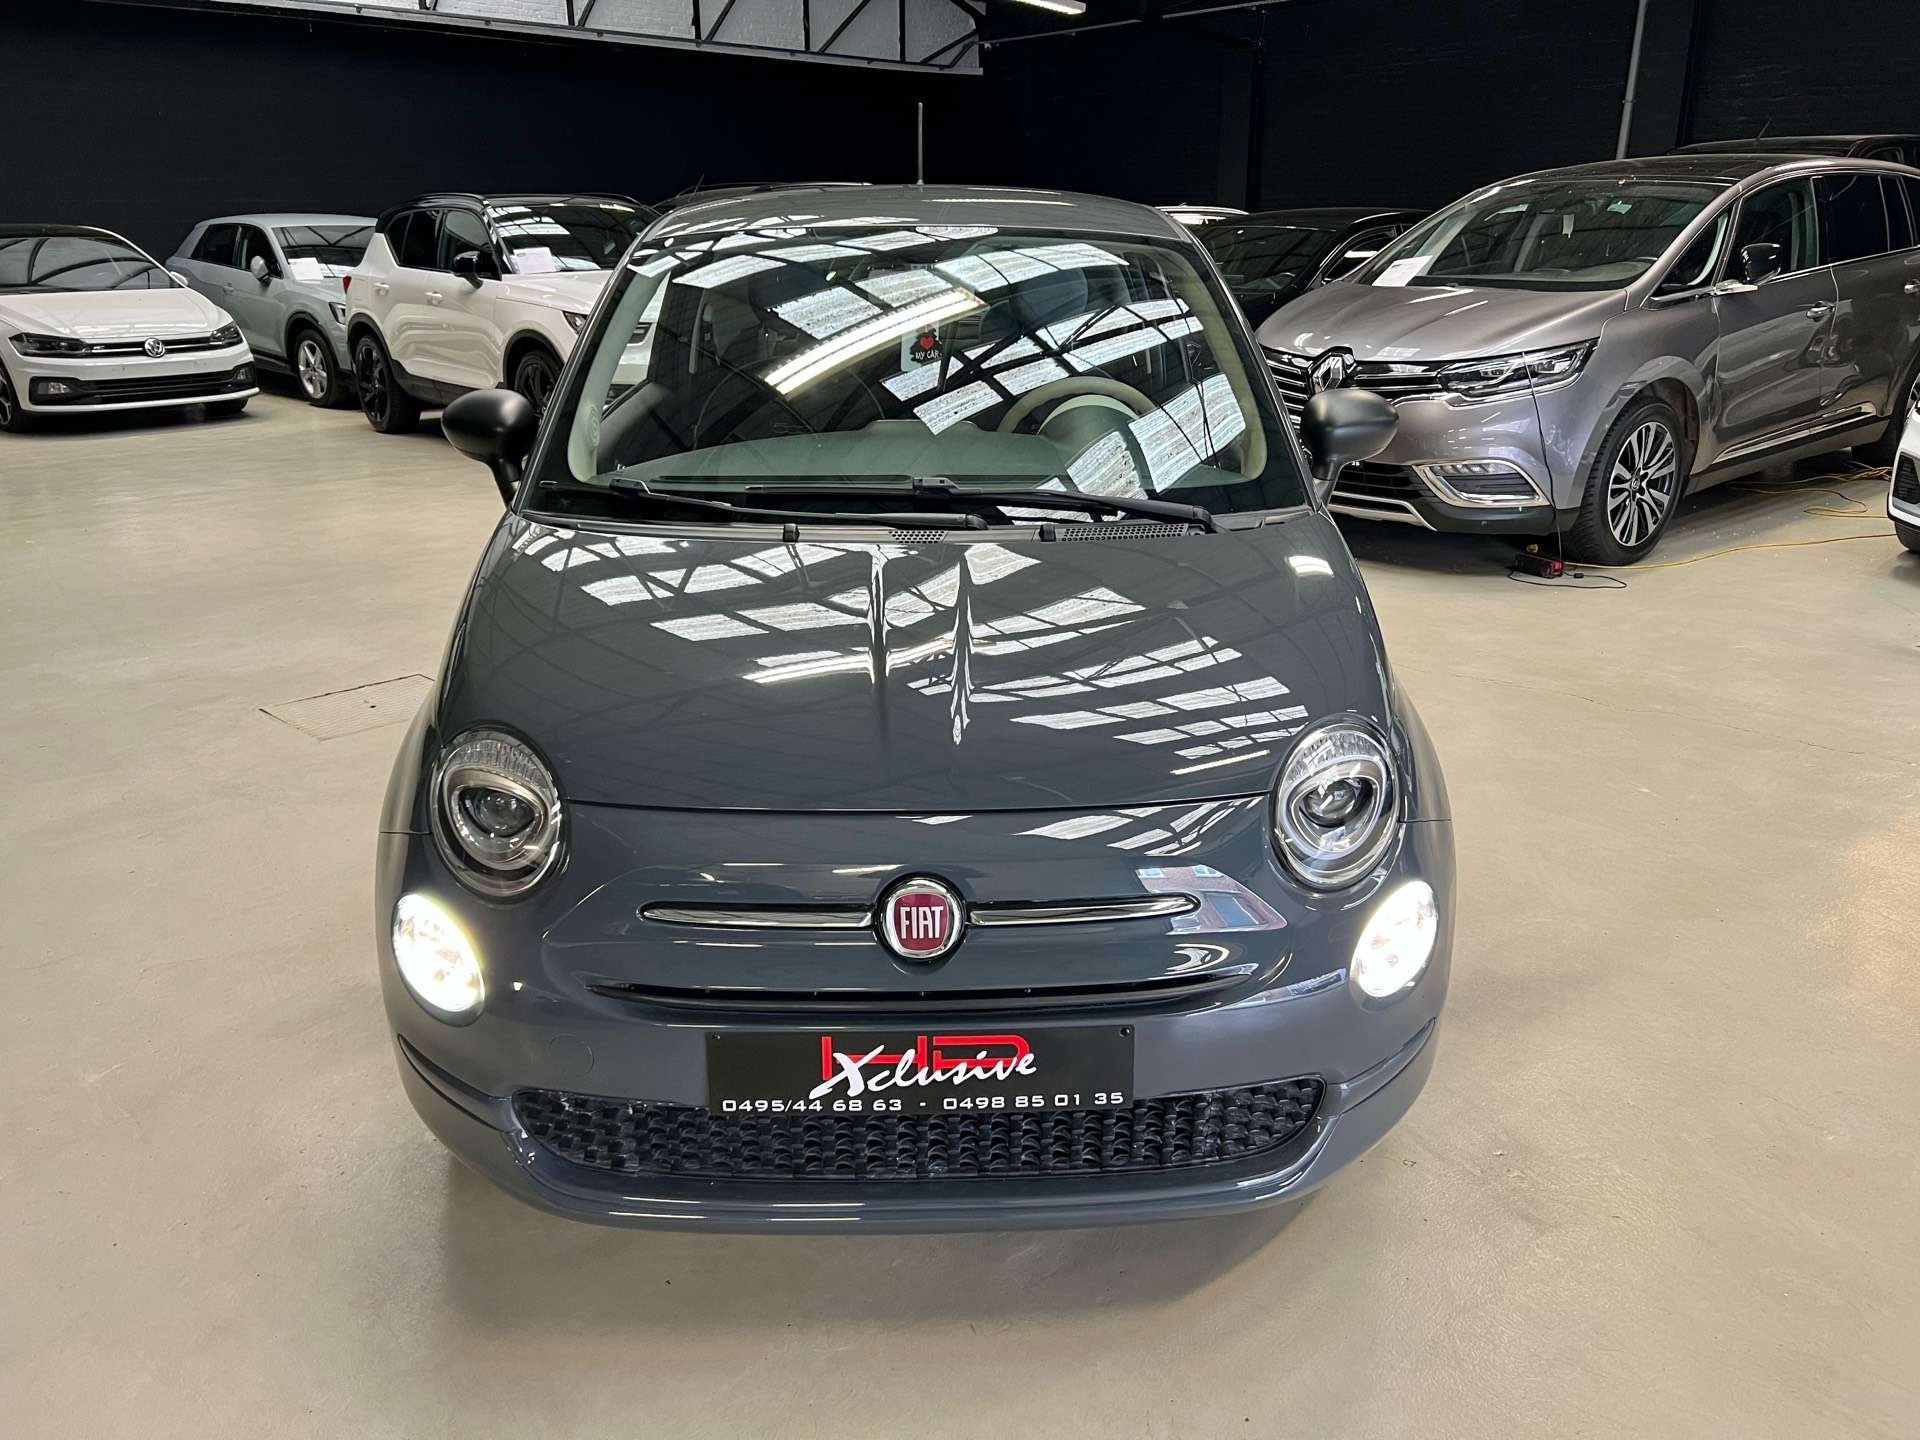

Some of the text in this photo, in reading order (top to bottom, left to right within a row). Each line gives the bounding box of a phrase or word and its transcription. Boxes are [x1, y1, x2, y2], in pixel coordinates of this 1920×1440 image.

[915, 349, 939, 360] MY CAR
[900, 906, 944, 939] FIAT
[808, 1044, 1037, 1099] Xclusive
[722, 1099, 823, 1112] 0495/44
[832, 1099, 862, 1112] 68
[872, 1099, 902, 1112] 63
[943, 1097, 1005, 1110] 0498
[1015, 1095, 1045, 1108] 85
[1054, 1094, 1081, 1106] 01
[1094, 1092, 1124, 1105] 35
